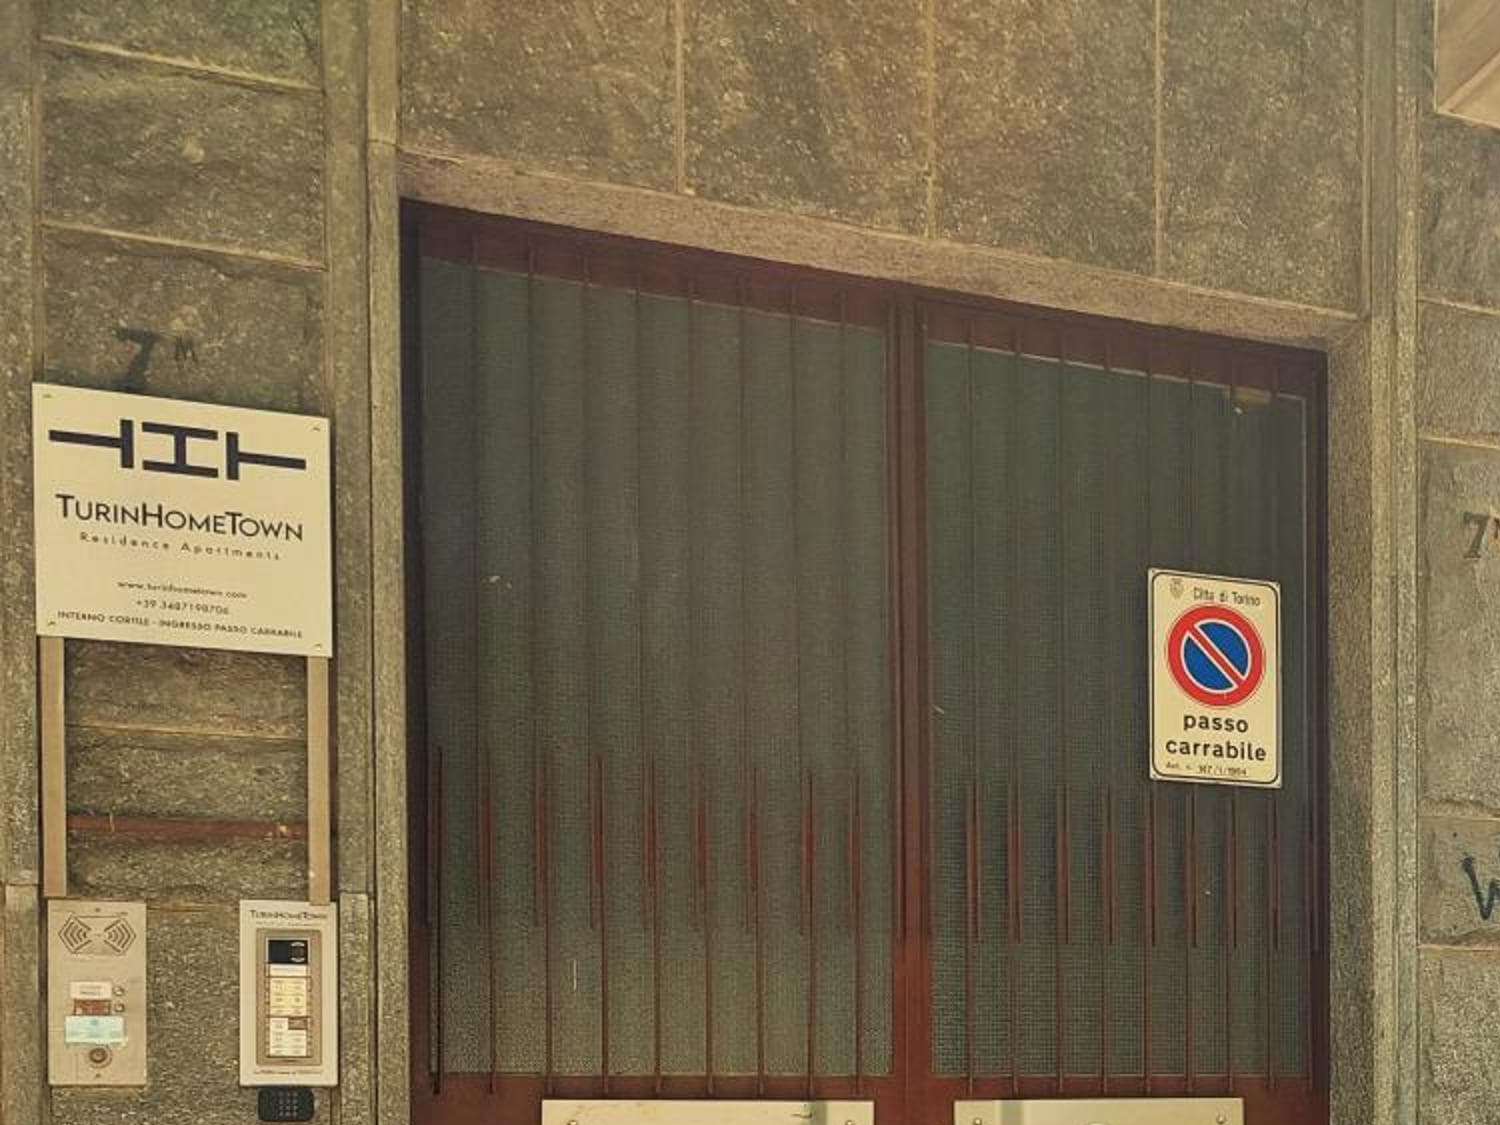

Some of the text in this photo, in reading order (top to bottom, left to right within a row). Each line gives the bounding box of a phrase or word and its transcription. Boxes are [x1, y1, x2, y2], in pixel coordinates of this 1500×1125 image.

[80, 531, 280, 560] Residence Apartments
[57, 610, 105, 623] INTERNO
[108, 615, 150, 626] CORTILE
[159, 619, 212, 632] INGRESSO
[214, 623, 247, 634] PASSO
[1183, 714, 1249, 733] passo
[1165, 740, 1266, 761] carrabile
